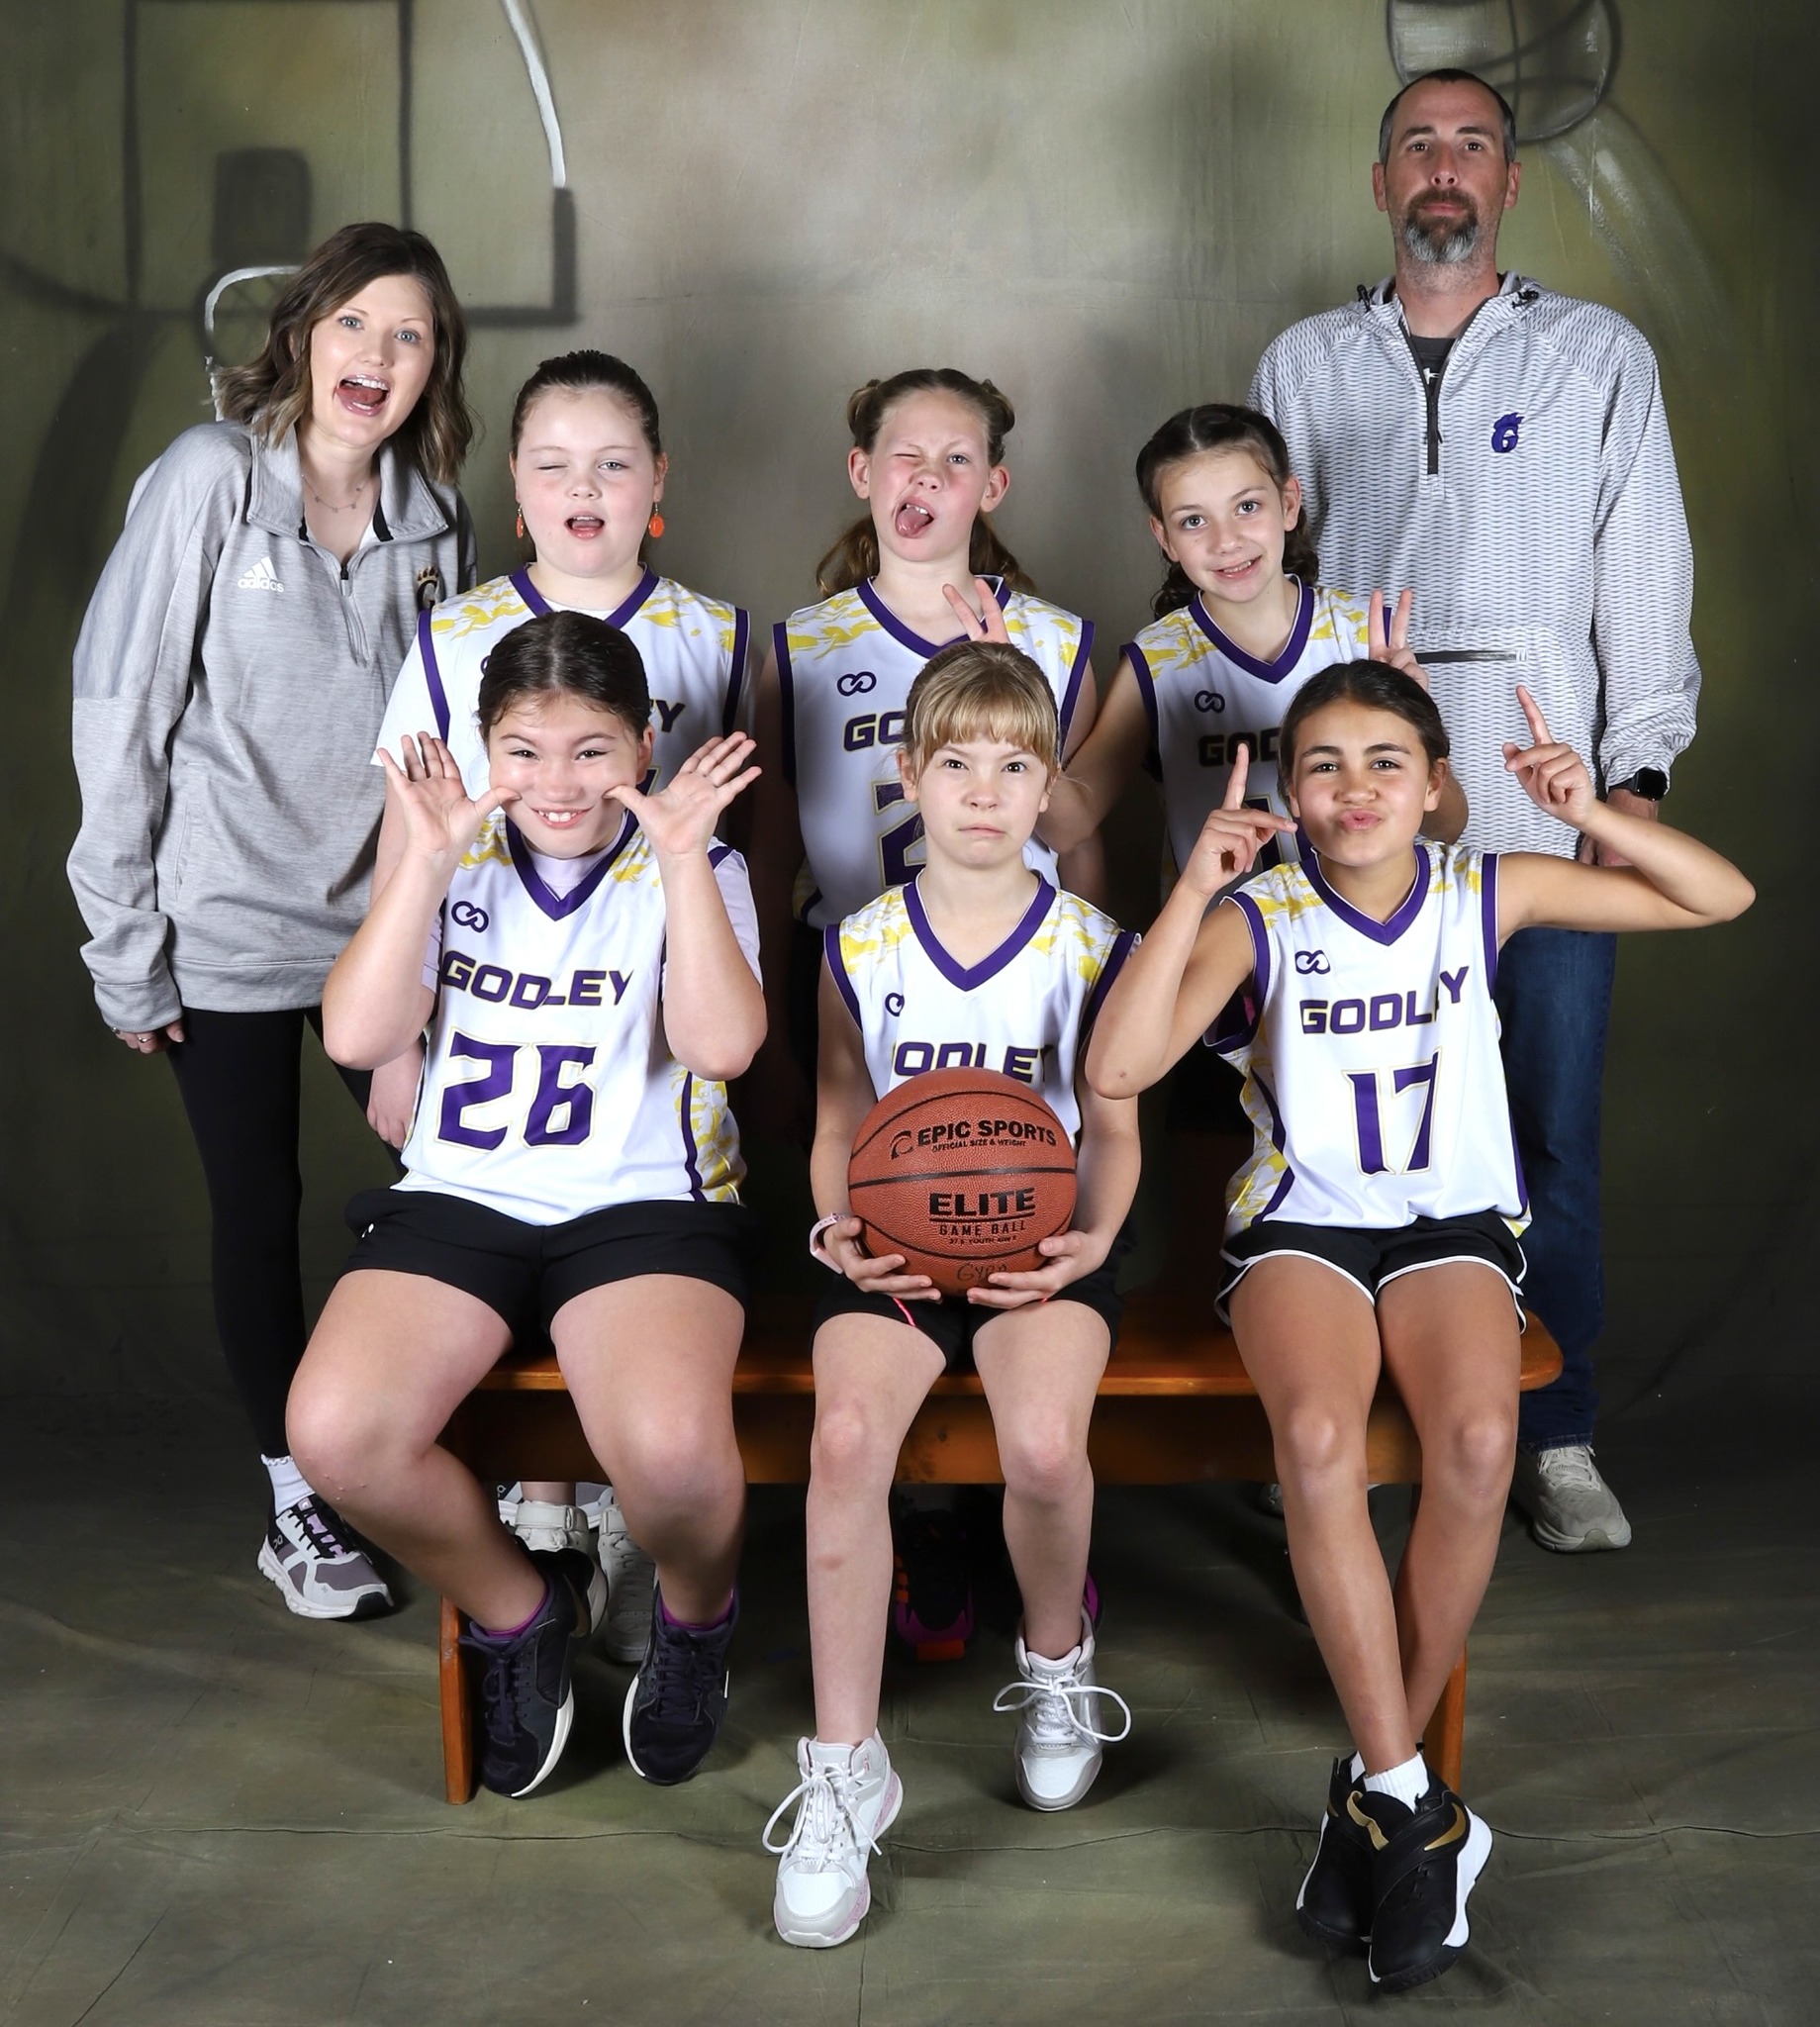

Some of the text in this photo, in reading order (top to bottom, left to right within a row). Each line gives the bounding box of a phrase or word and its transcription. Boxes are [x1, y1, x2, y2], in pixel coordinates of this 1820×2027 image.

[238, 577, 284, 593] adidas
[441, 950, 633, 1010] GODLEY
[1299, 966, 1470, 1034] GODLY
[433, 1025, 599, 1153] 26
[1340, 1045, 1443, 1178] 17
[917, 1119, 1057, 1147] EPIC SPORTS
[931, 1140, 968, 1153] OFFICIAL
[998, 1138, 1026, 1147] WEIGHT
[928, 1187, 1036, 1216] ELITE
[939, 1219, 1025, 1237] GAME BALL
